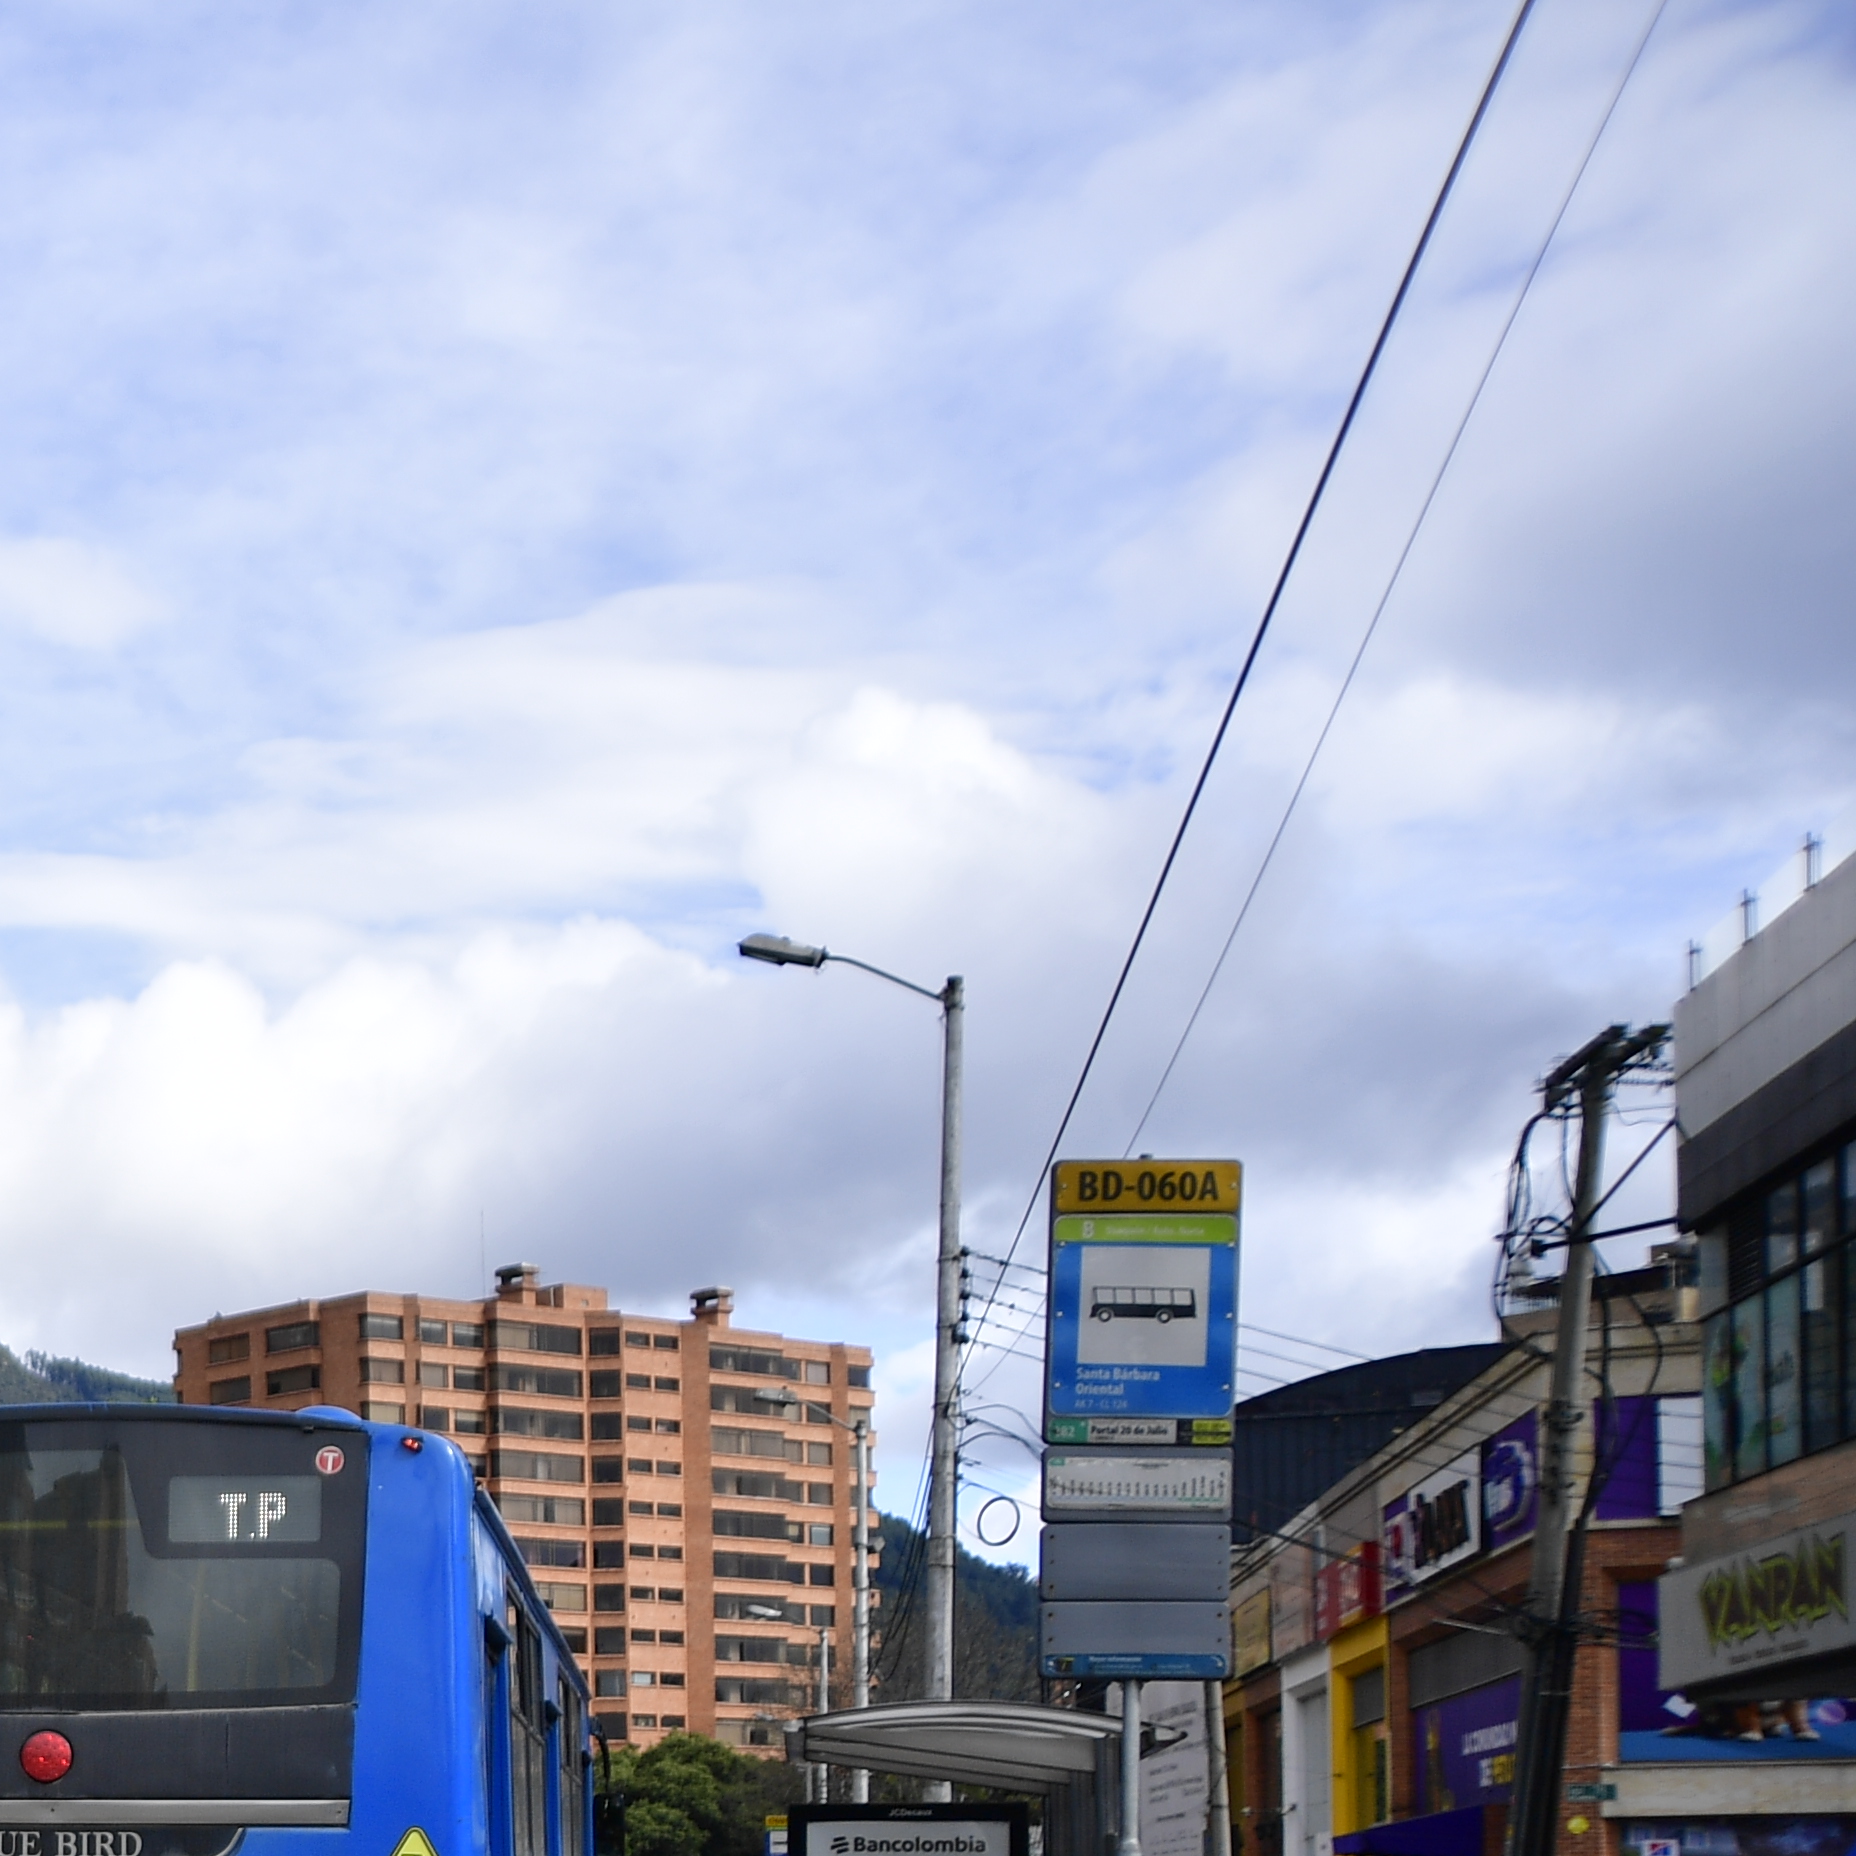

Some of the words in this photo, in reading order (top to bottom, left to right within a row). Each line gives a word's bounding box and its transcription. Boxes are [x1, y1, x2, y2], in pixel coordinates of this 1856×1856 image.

[1078, 1170, 1219, 1202] BD-060A
[1076, 1366, 1111, 1380] Santa
[1113, 1366, 1161, 1381] Bárbara
[1075, 1382, 1124, 1396] Oriental
[1091, 1424, 1119, 1436] Portal
[1121, 1425, 1132, 1436] 20
[1134, 1425, 1145, 1435] de
[1147, 1425, 1168, 1436] Julio
[853, 1836, 986, 1853] Bancolombia
